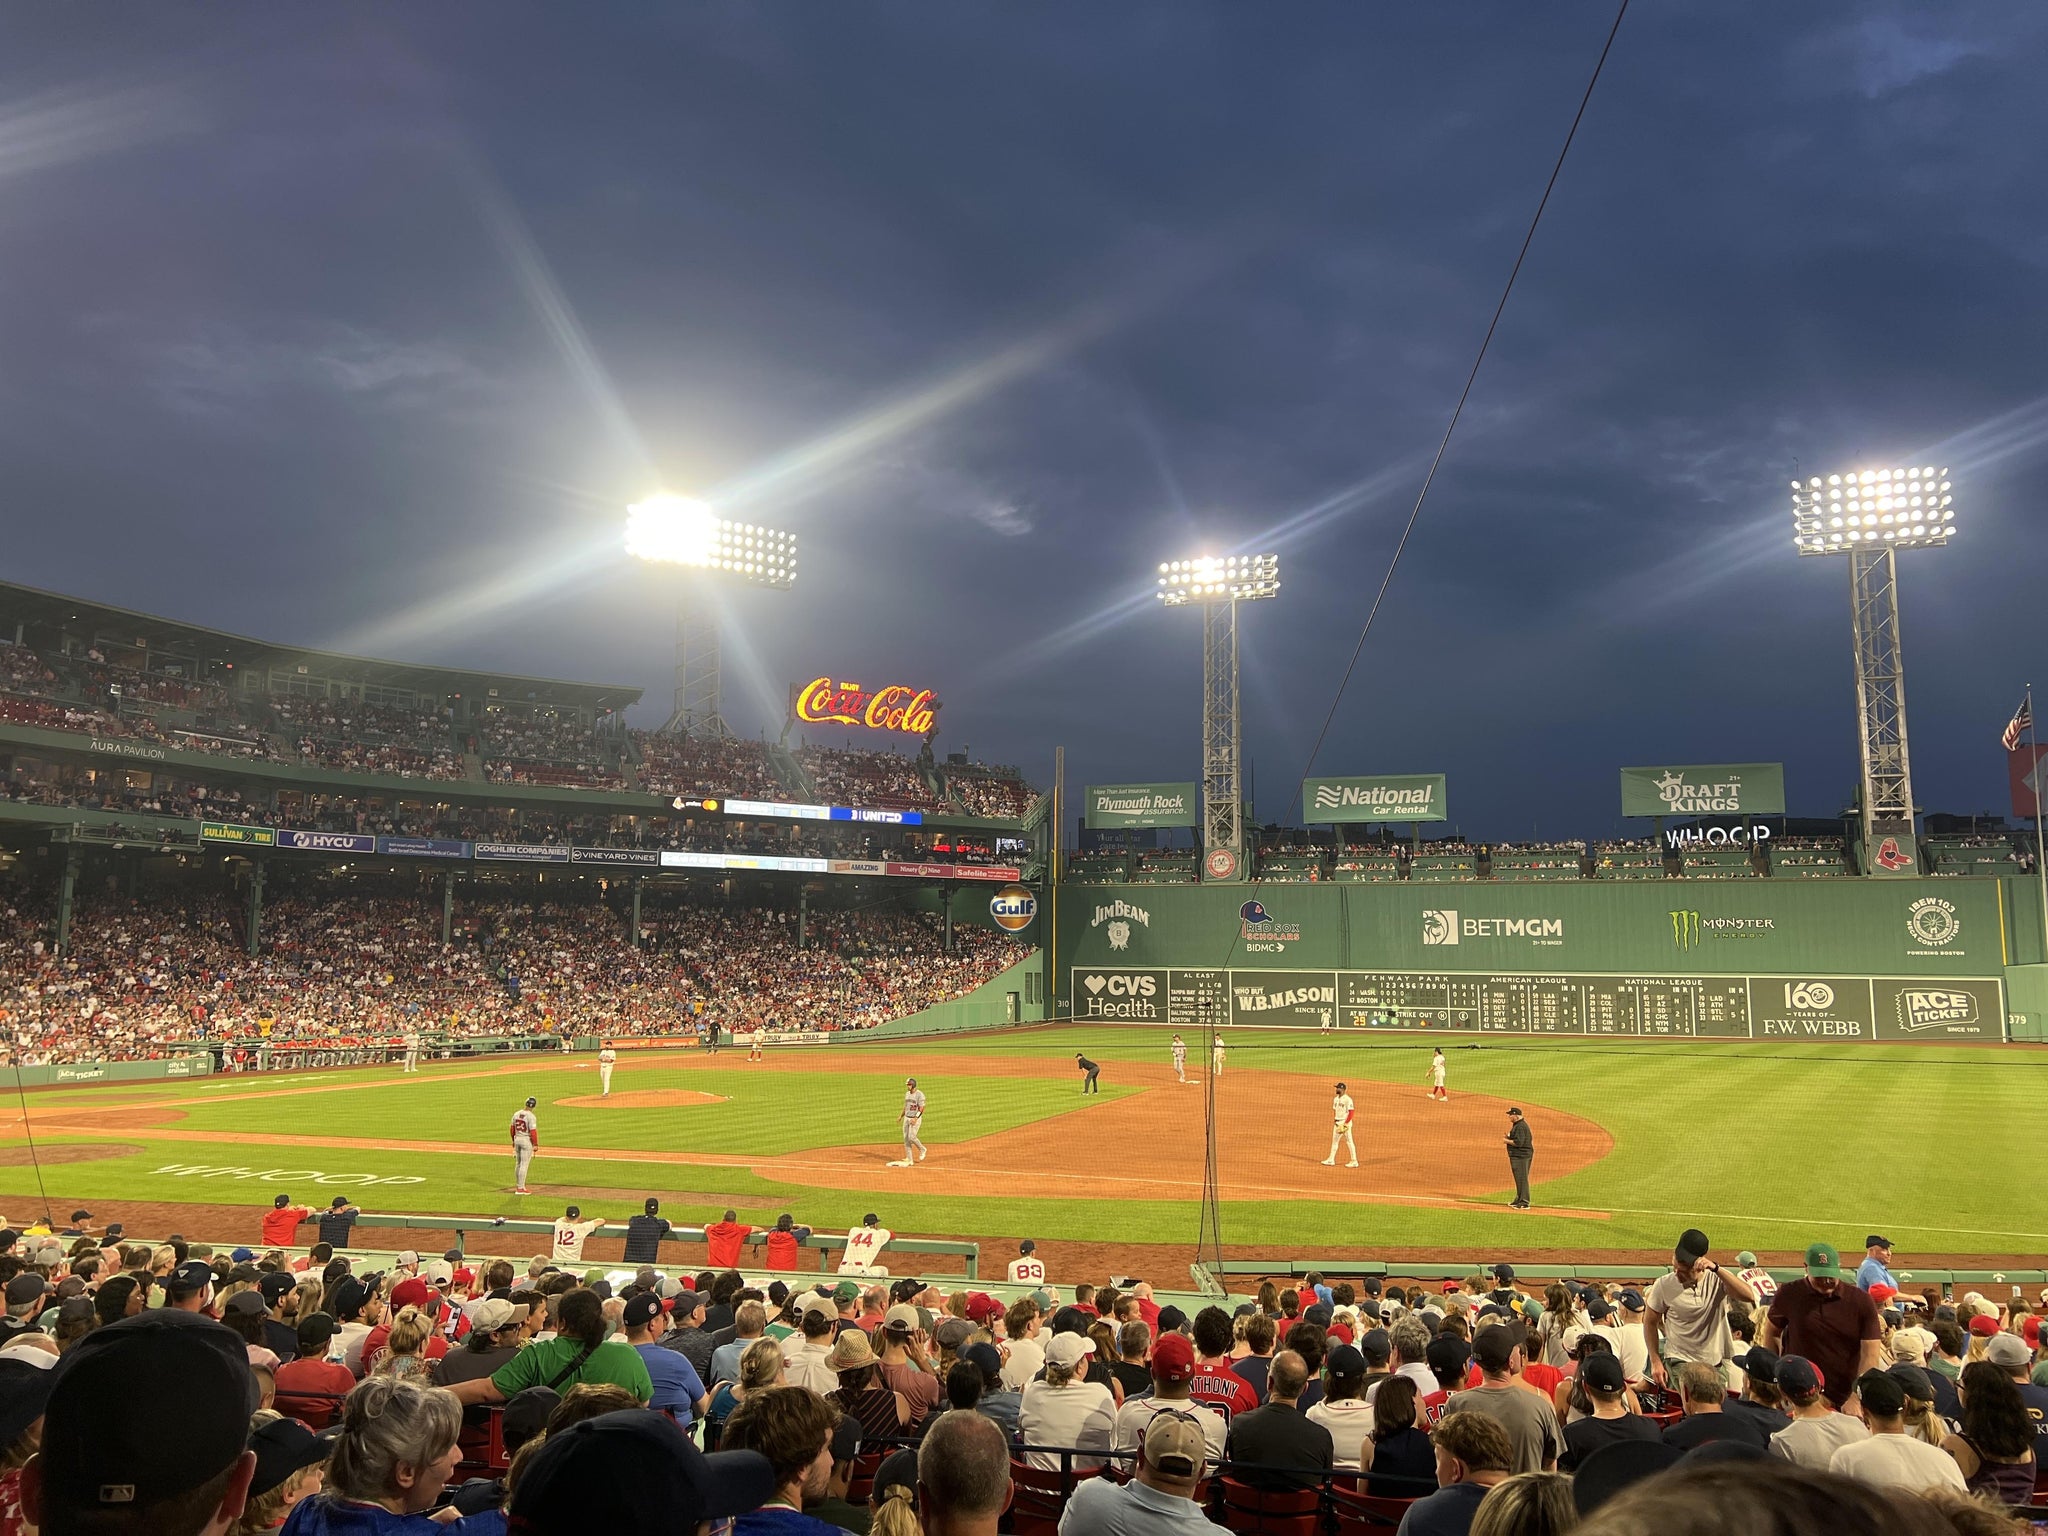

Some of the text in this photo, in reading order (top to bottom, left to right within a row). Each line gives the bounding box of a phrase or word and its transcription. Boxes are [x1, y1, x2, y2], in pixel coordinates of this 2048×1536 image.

[124, 746, 165, 759] PAVILION
[1341, 785, 1432, 805] National
[1660, 784, 1741, 801] DRAFT
[1096, 795, 1184, 811] Plymouth Rock
[1670, 798, 1740, 812] KINGS
[862, 811, 903, 822] UNITED
[1373, 805, 1428, 815] Car Rental
[203, 827, 271, 842] SULLIVAN TIRE
[1666, 825, 1770, 849] WHOOP
[313, 836, 353, 848] HYCU
[477, 845, 568, 856] COGHLIN COMPANIES
[582, 851, 627, 860] VINEYARD
[629, 854, 656, 862] VINES
[851, 864, 879, 872] AMAZING
[900, 866, 918, 874] Ninety
[957, 869, 988, 877] Safelite
[992, 901, 1034, 915] Gulf
[1908, 897, 1956, 913] IBEW 103
[1091, 900, 1150, 928] JIM BEAM
[1246, 923, 1300, 932] RED SOX
[1463, 919, 1562, 936] BETMGM
[1702, 917, 1775, 929] MONSTER
[1246, 932, 1300, 940] SCHOLARS
[1917, 920, 1960, 946] CONTRACTORS
[1246, 943, 1275, 952] BIDMC
[1107, 975, 1156, 996] CVS
[1233, 987, 1249, 995] WHO
[1784, 982, 1834, 1009] 160
[1912, 991, 1968, 1010] ACE
[1057, 1000, 1070, 1008] 310
[1087, 998, 1157, 1018] Health
[1353, 1016, 1366, 1026] 29
[1914, 1009, 1969, 1021] TICKET
[2008, 1015, 2027, 1024] 379
[1763, 1020, 1861, 1036] F.W. WEBB
[76, 1070, 105, 1080] TICKET
[516, 1119, 527, 1132] 23
[150, 1164, 427, 1186] WHOOP
[557, 1230, 575, 1245] 12
[851, 1233, 873, 1247] 44
[1818, 1253, 1828, 1264] B
[1017, 1264, 1042, 1279] 83
[1752, 1279, 1775, 1297] 19
